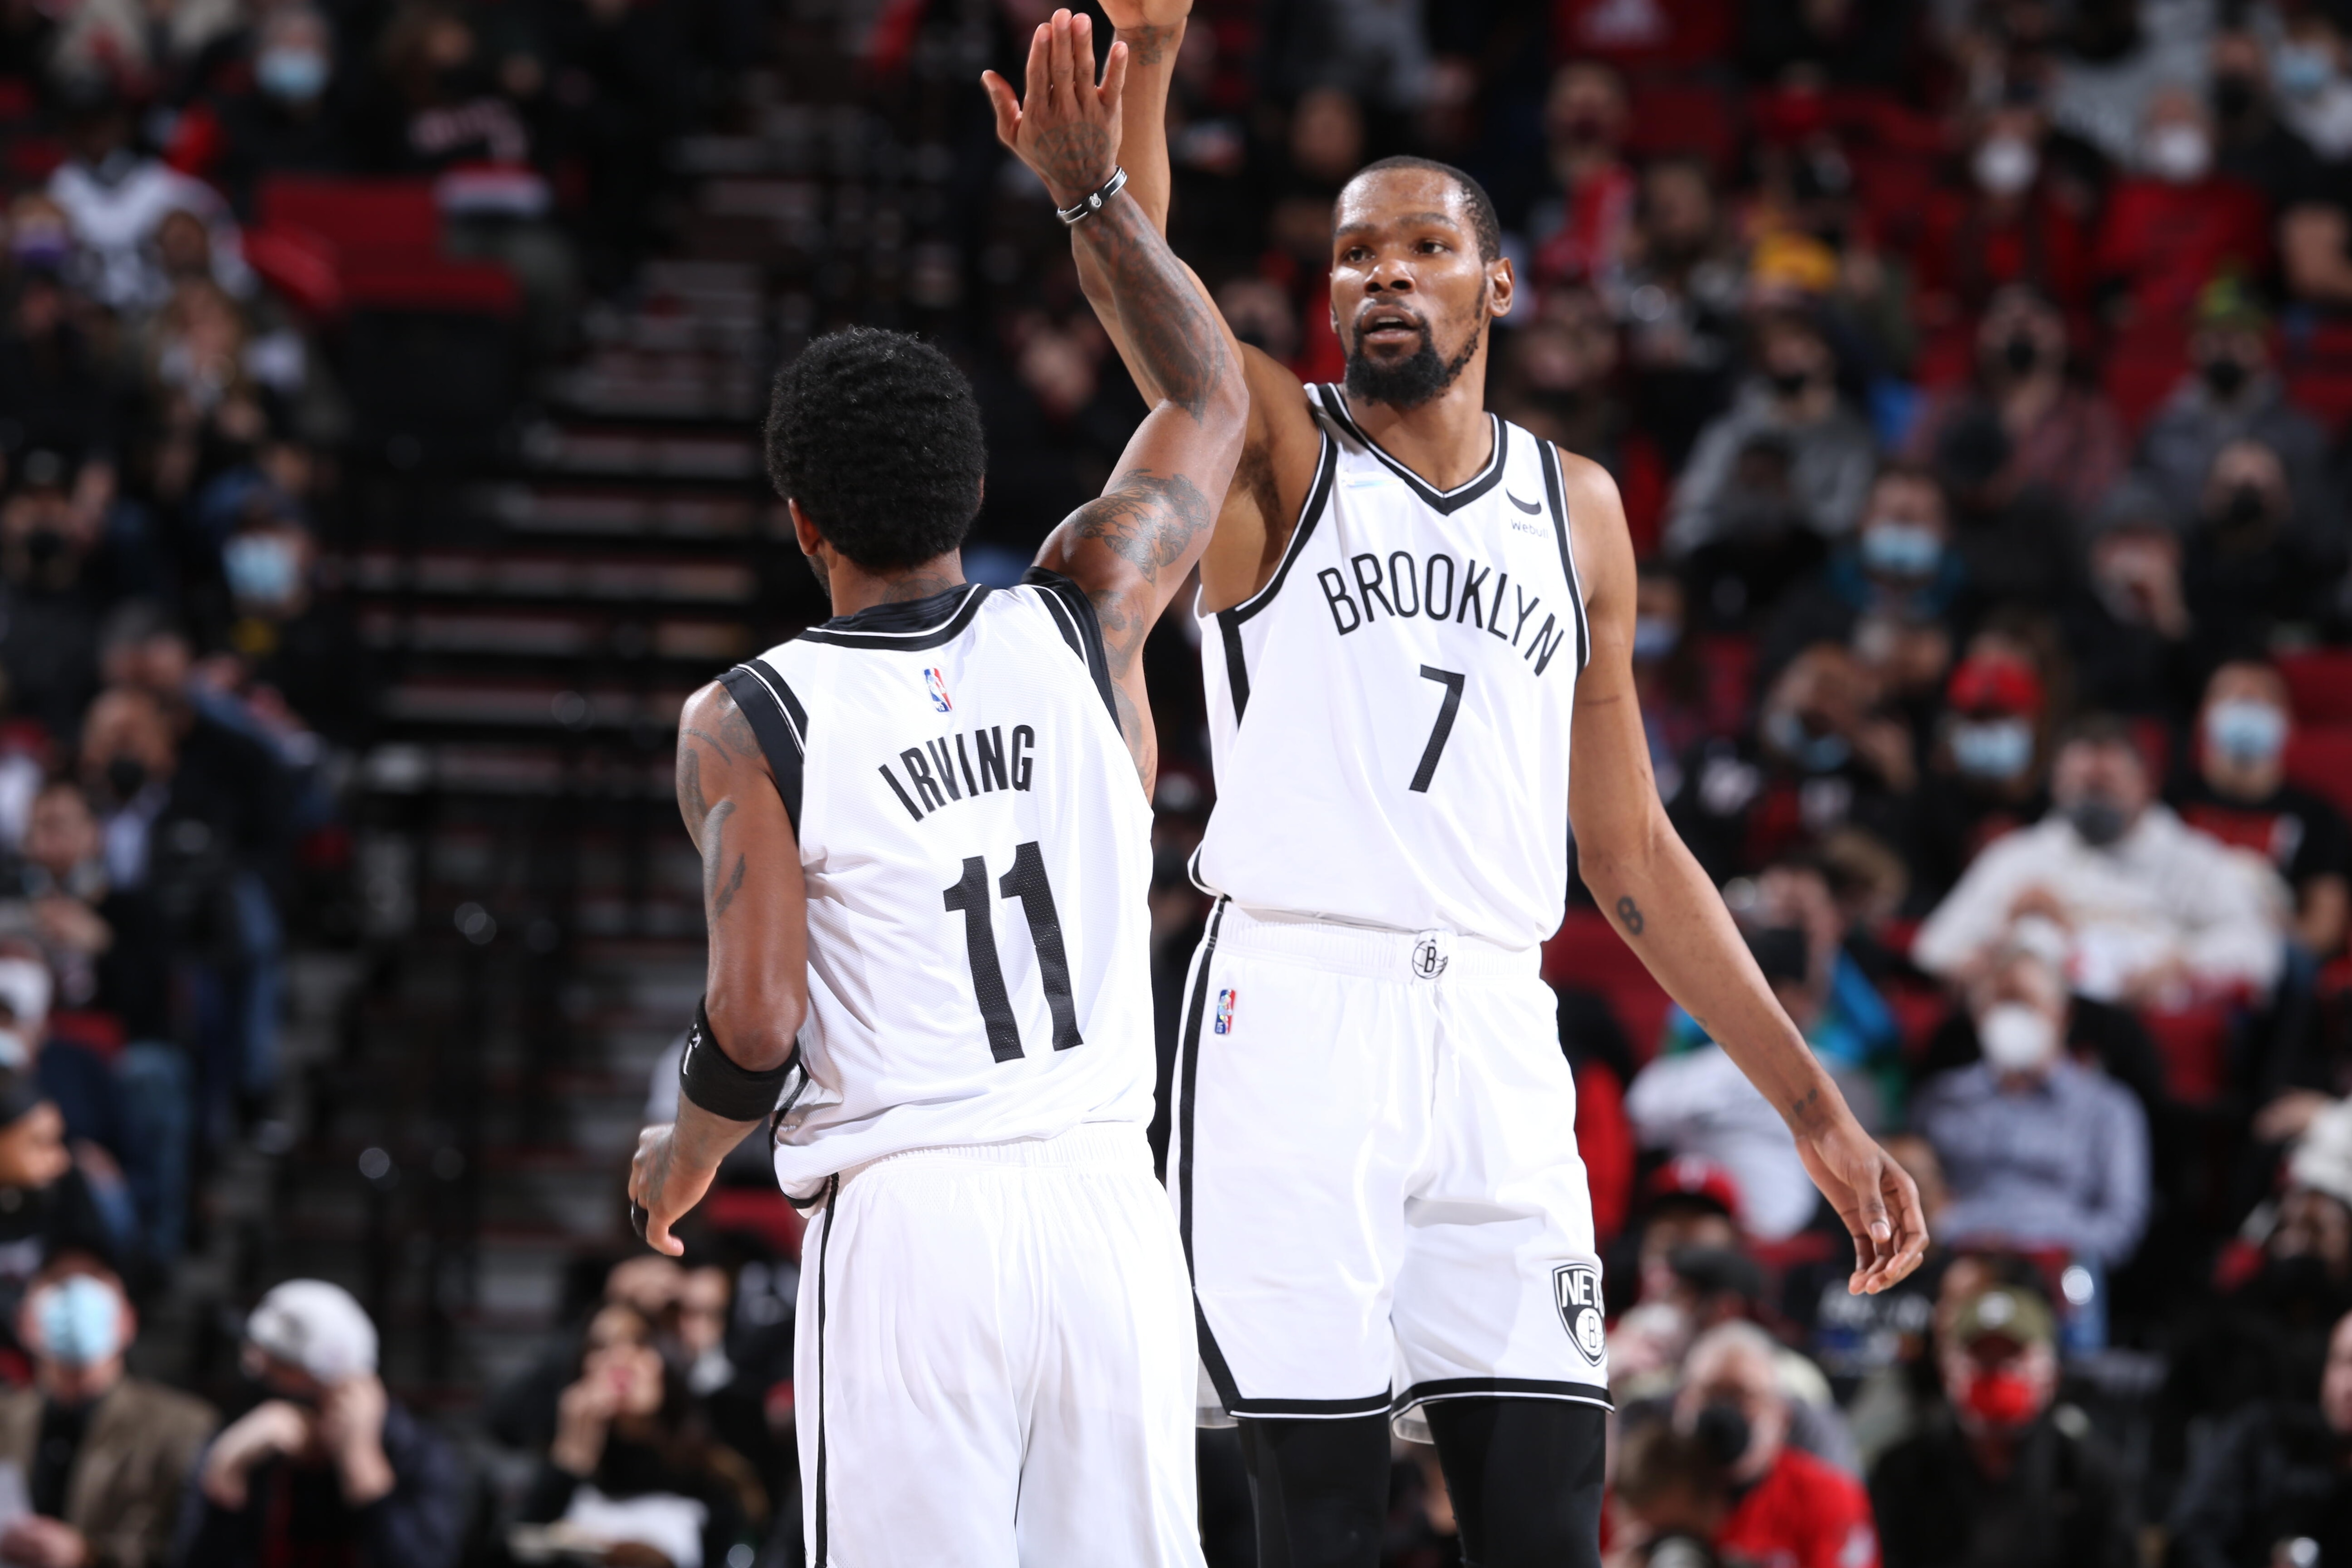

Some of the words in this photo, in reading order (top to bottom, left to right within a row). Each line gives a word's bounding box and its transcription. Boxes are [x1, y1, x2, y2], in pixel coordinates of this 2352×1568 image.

[1510, 518, 1549, 540] Webull
[1317, 551, 1564, 677] BROOKLYN
[878, 724, 1035, 822] IRVING
[1409, 664, 1465, 793] 7
[943, 841, 1084, 1064] 11
[1424, 946, 1437, 972] B
